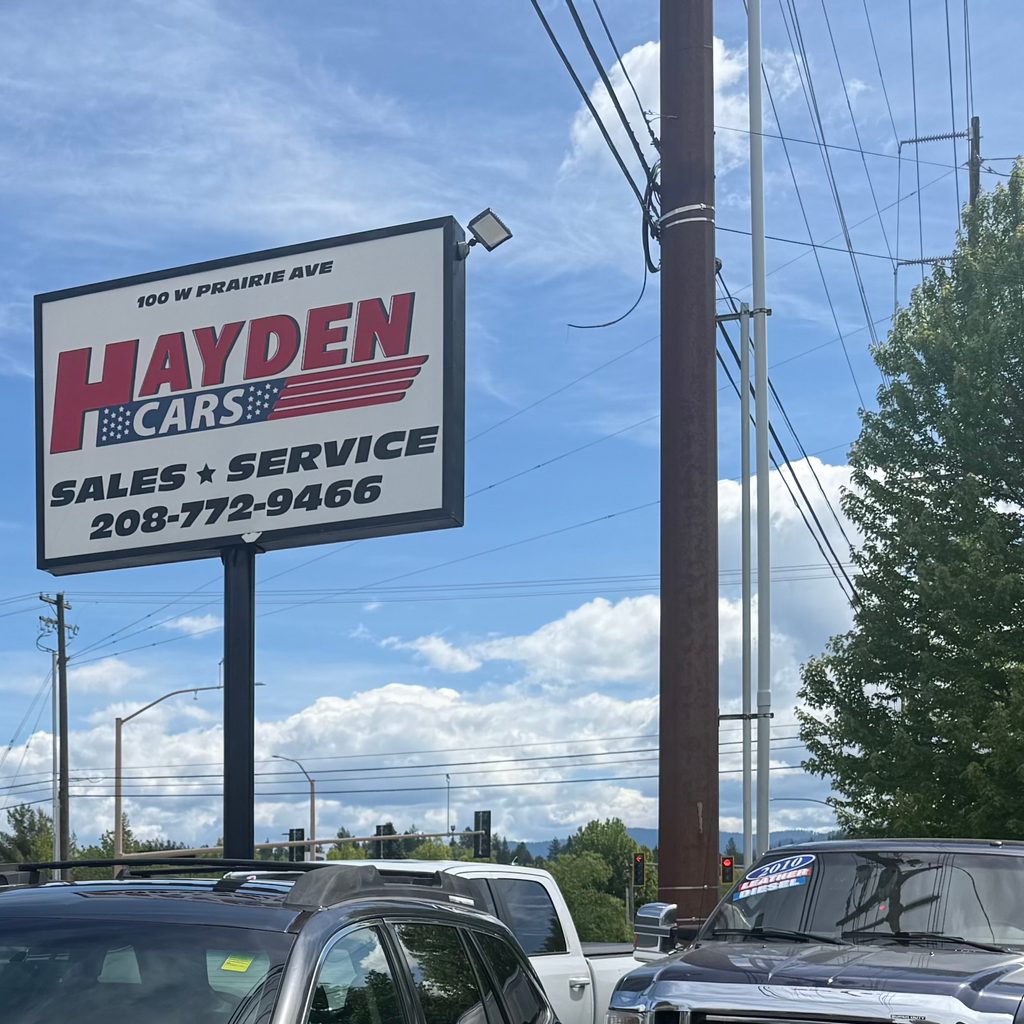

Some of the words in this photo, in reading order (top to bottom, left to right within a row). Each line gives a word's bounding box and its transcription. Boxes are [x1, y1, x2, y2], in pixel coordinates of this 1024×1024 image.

[137, 291, 169, 308] 100
[174, 287, 193, 302] W
[196, 269, 286, 297] PRAIRIE
[288, 260, 334, 280] AVE
[50, 292, 415, 454] HAYDEN
[133, 388, 245, 437] CARS
[50, 463, 187, 507] SALES
[226, 425, 440, 482] SERVICE
[89, 475, 383, 541] 208-772-9466
[738, 878, 801, 899] DIESEL
[758, 857, 803, 878] 2010
